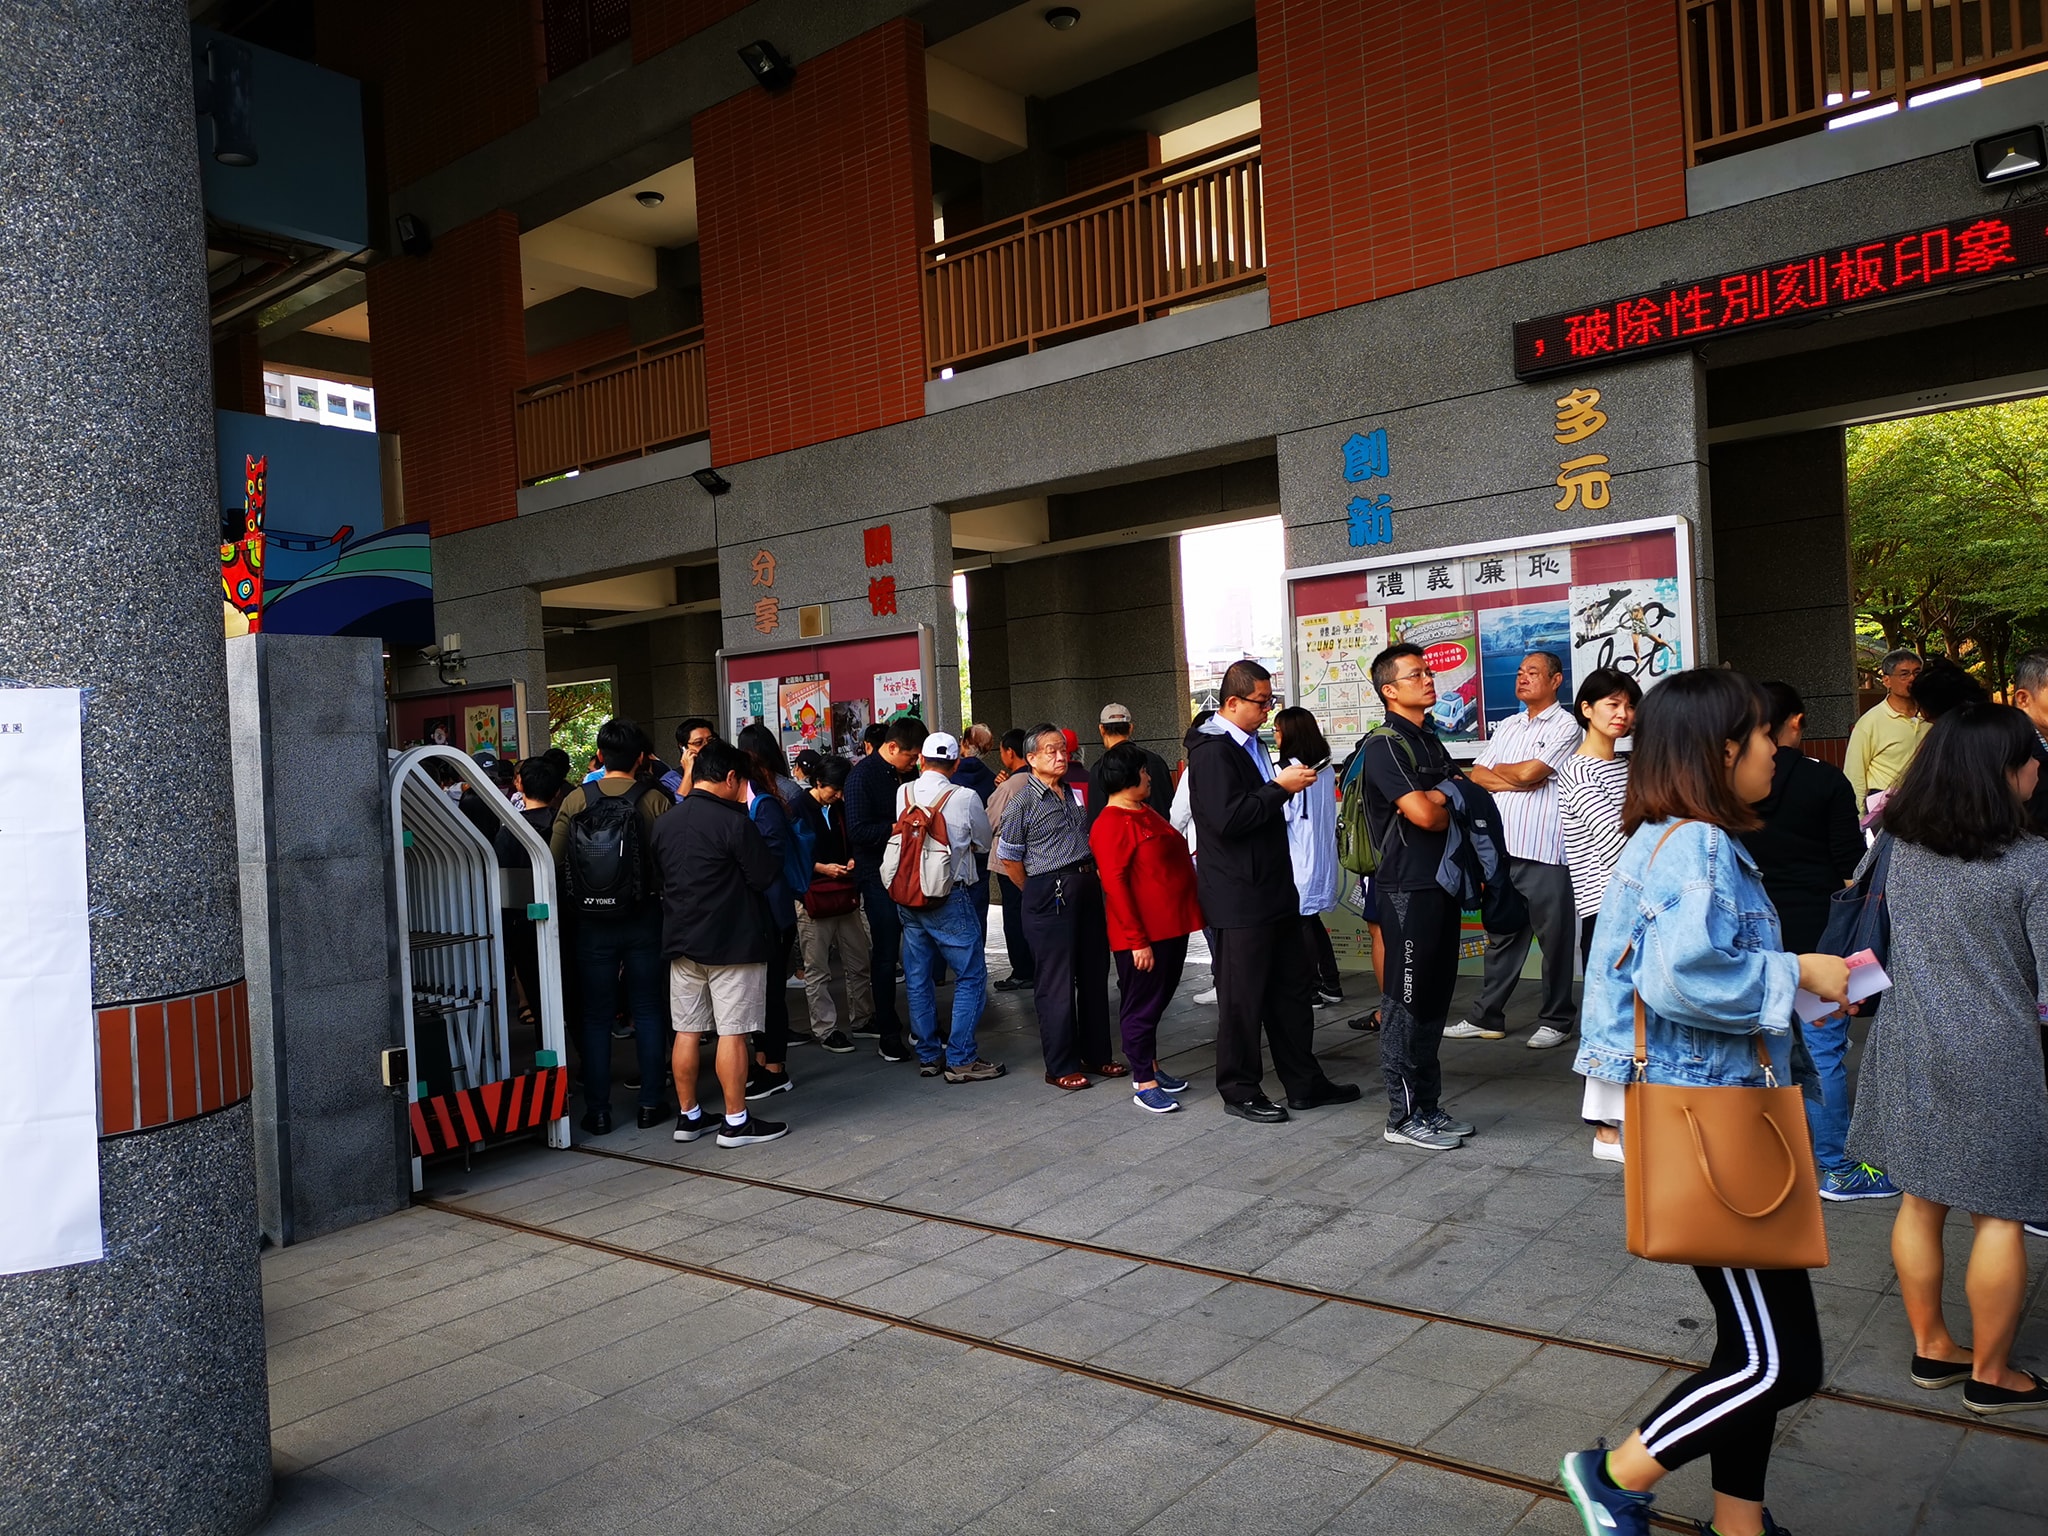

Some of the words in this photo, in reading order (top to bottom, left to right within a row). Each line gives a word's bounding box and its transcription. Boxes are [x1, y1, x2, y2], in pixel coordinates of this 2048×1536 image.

[1342, 428, 1393, 547] 創新
[1554, 388, 1612, 511] 多元
[751, 549, 779, 634] 分享
[595, 897, 616, 905] YONEX
